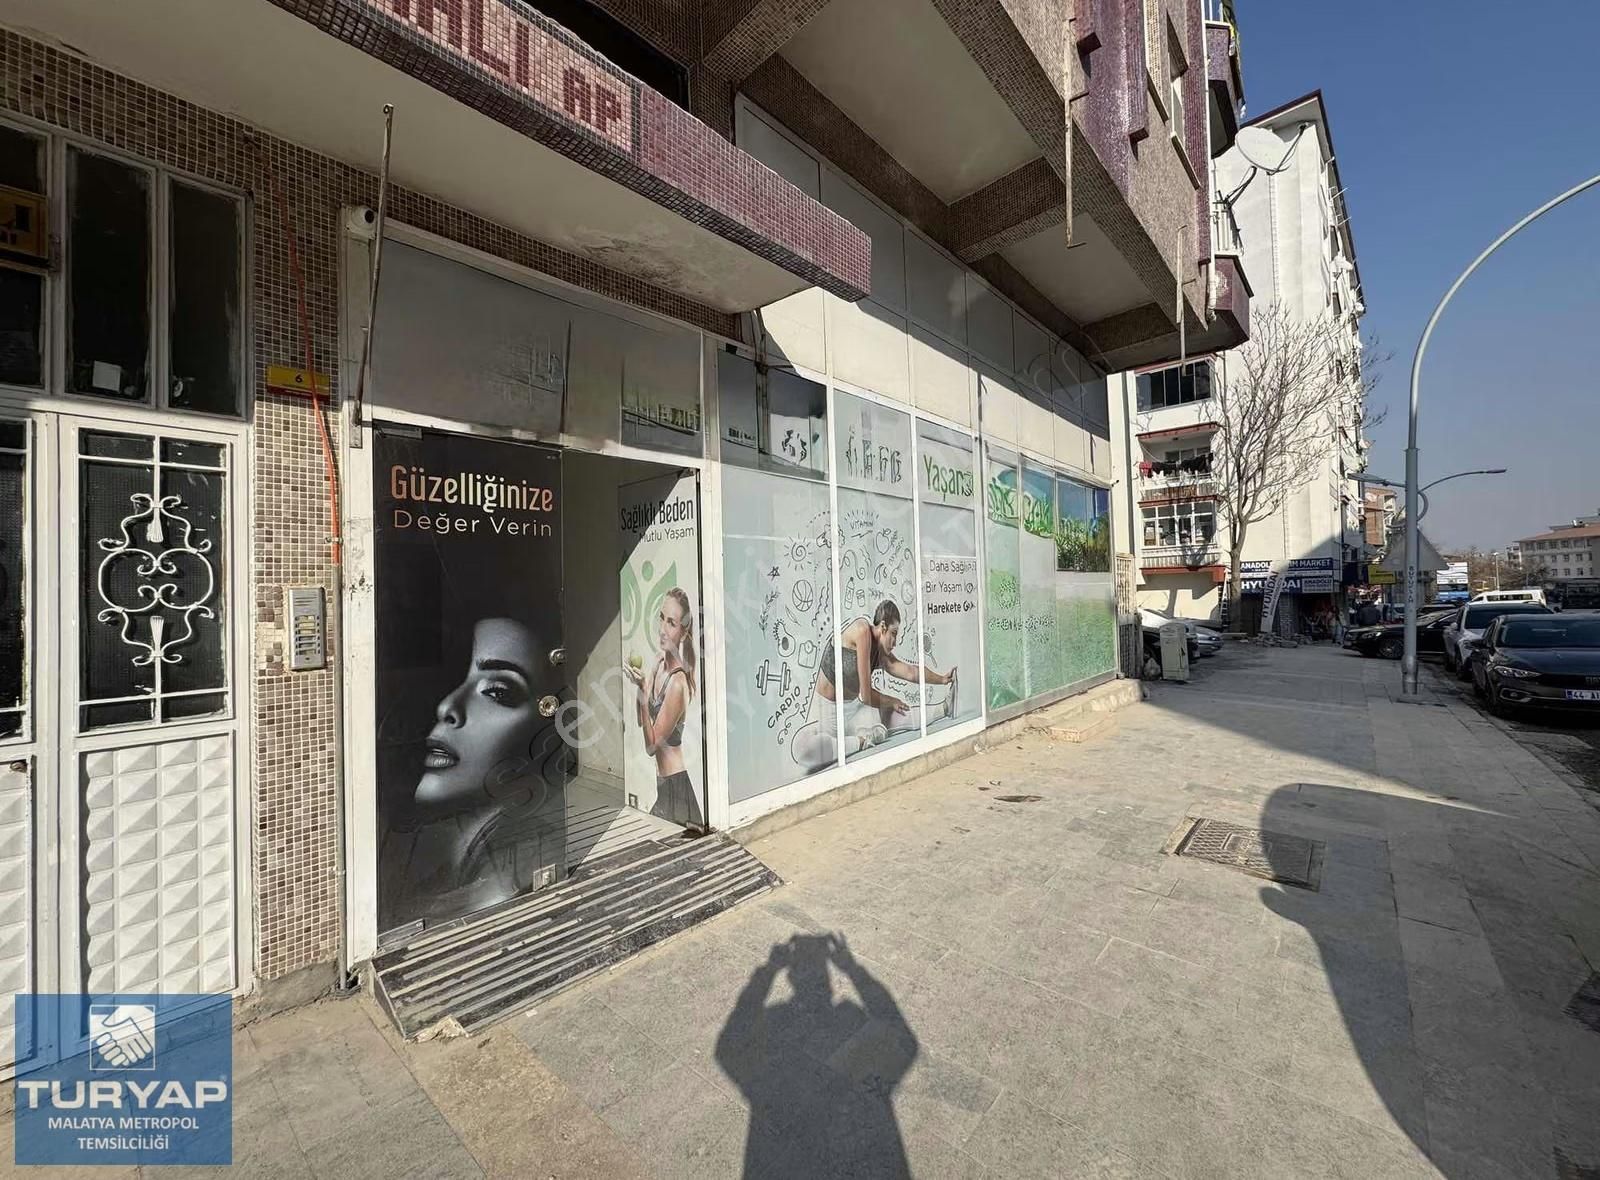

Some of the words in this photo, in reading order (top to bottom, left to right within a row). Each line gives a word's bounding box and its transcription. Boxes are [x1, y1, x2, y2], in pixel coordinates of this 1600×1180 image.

[562, 65, 622, 134] AP
[295, 372, 303, 383] 6
[390, 464, 553, 514] Güzelliğinize
[394, 509, 480, 535] Değer
[489, 515, 552, 537] Verin
[620, 502, 656, 534] Sağlıklı
[659, 496, 694, 525] Beden
[664, 526, 694, 540] Yaşam
[925, 581, 937, 593] Bir
[938, 581, 962, 595] Yaşam
[927, 601, 962, 615] Harekete
[767, 686, 801, 729] CARDIO
